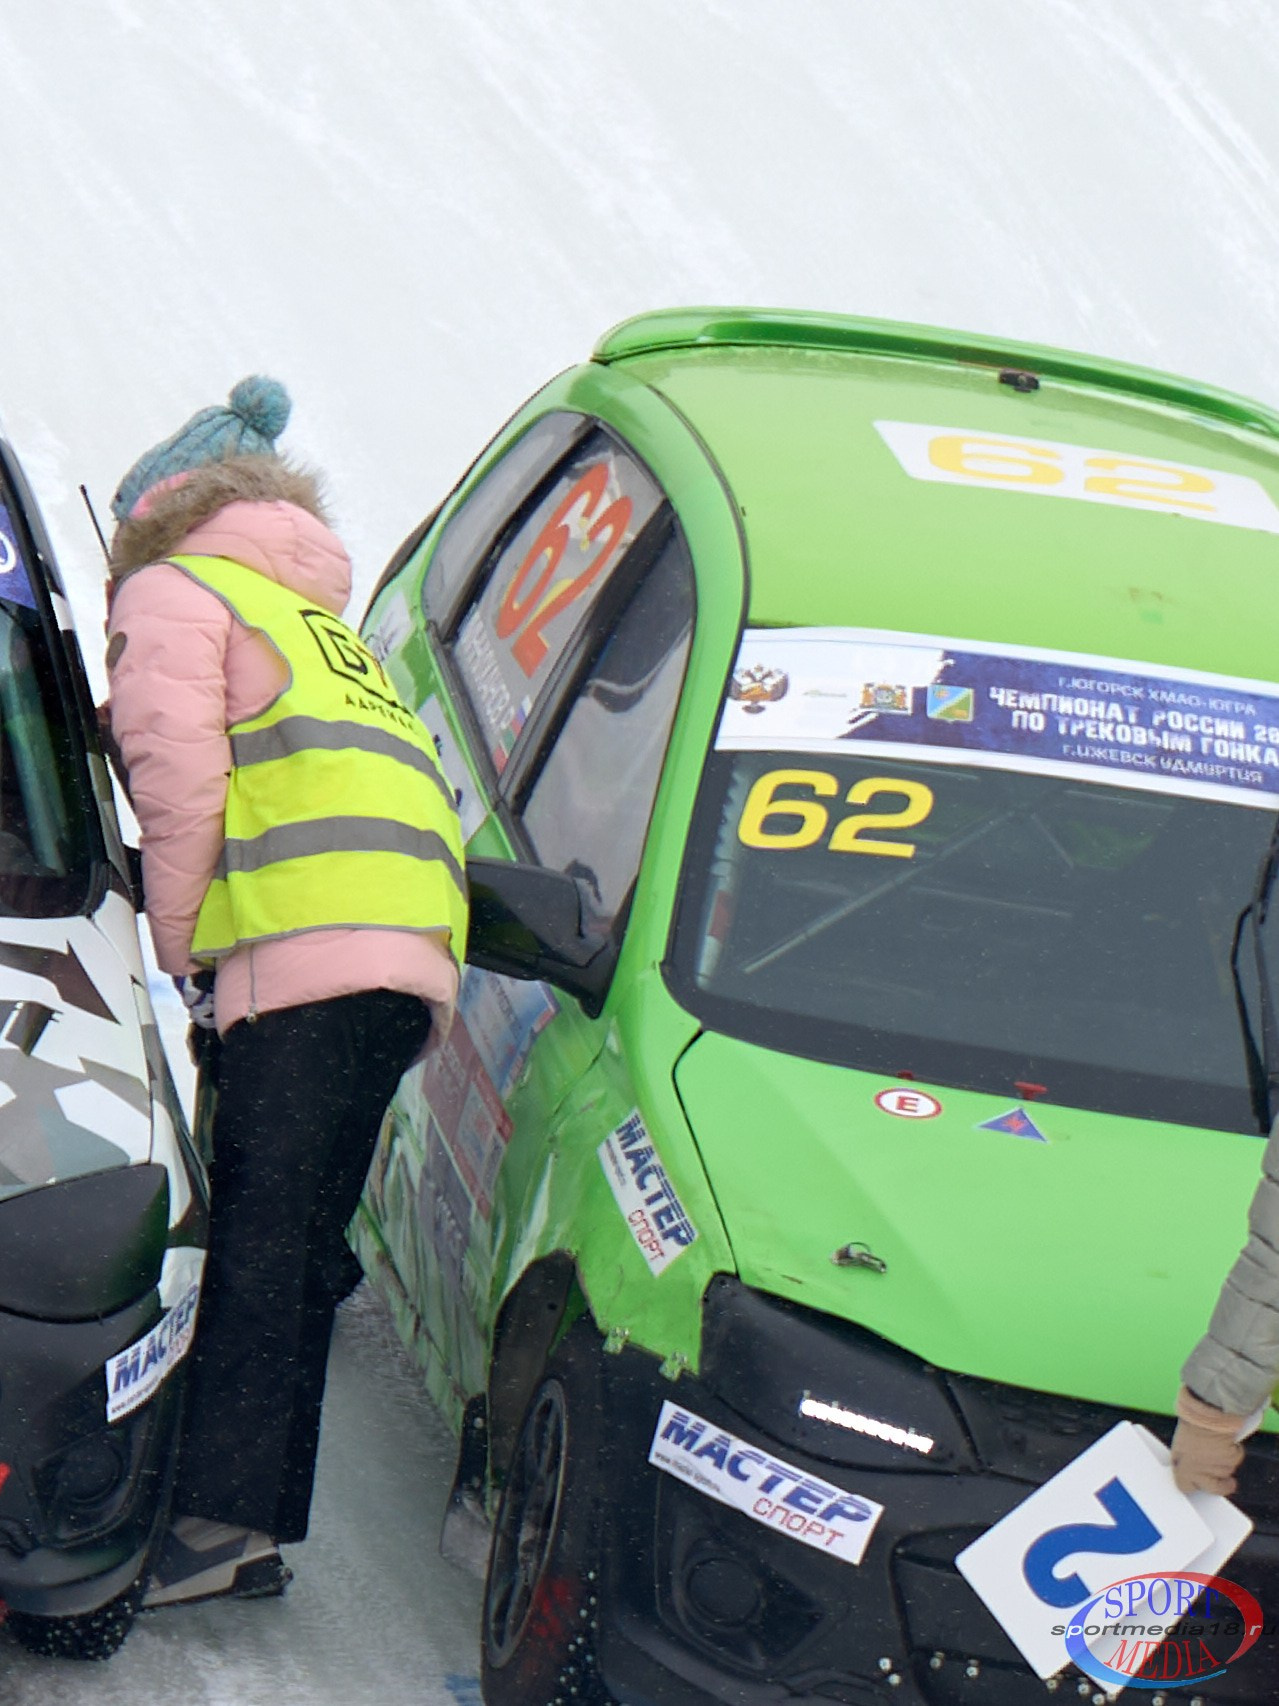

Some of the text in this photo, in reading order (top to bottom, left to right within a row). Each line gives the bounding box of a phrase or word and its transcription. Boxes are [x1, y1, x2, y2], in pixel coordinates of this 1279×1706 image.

[928, 434, 1217, 512] 62
[989, 686, 1140, 724] ЧЕМПИОНАТ
[1152, 709, 1246, 740] РОССИИ
[1011, 710, 1046, 732] ПО
[1056, 716, 1193, 753] ТРЕКОВЫМ
[1160, 757, 1264, 784] УДМУРТИЯ
[737, 768, 934, 859] 62
[895, 1095, 919, 1114] E
[615, 1113, 697, 1247] МАСТЕР
[659, 1410, 872, 1523] МАСТЕР
[752, 1496, 844, 1546] СПОРТ
[1022, 1475, 1163, 1610] 2
